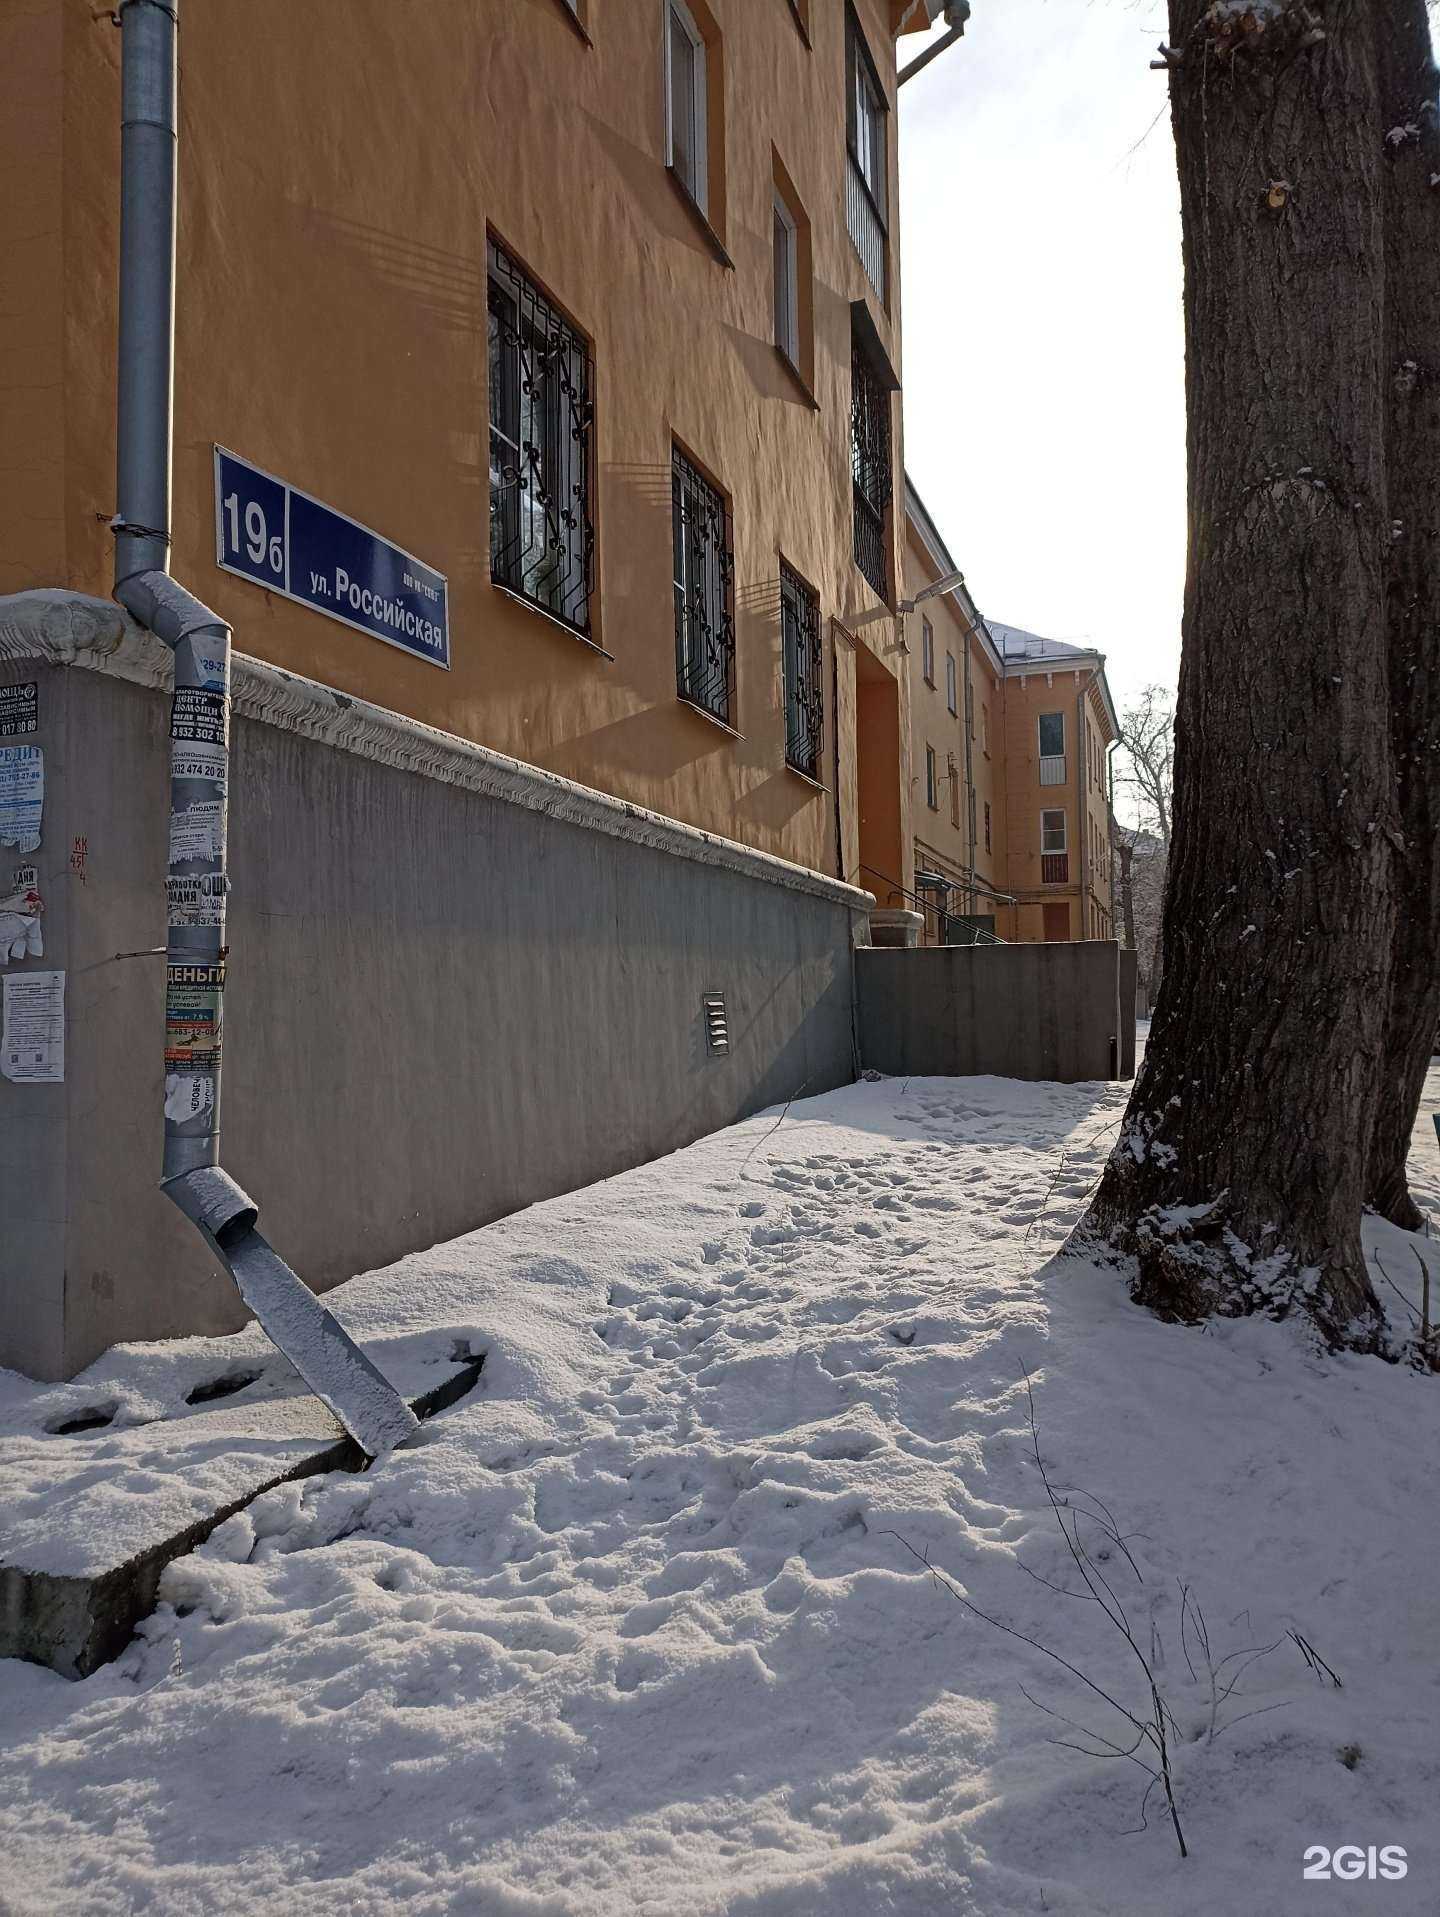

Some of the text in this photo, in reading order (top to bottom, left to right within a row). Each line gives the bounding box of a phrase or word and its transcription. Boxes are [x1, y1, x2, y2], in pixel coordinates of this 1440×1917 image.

[224, 492, 283, 573] 19б
[310, 571, 332, 596] ул.
[335, 566, 443, 650] Российская
[177, 695, 207, 704] ЦЕНТР
[175, 704, 217, 716] ПОМОЩИ
[196, 728, 214, 740] 302
[186, 764, 202, 775] 474
[205, 766, 215, 776] 20
[216, 768, 225, 778] 20
[168, 967, 225, 984] ДЕНЬГИ
